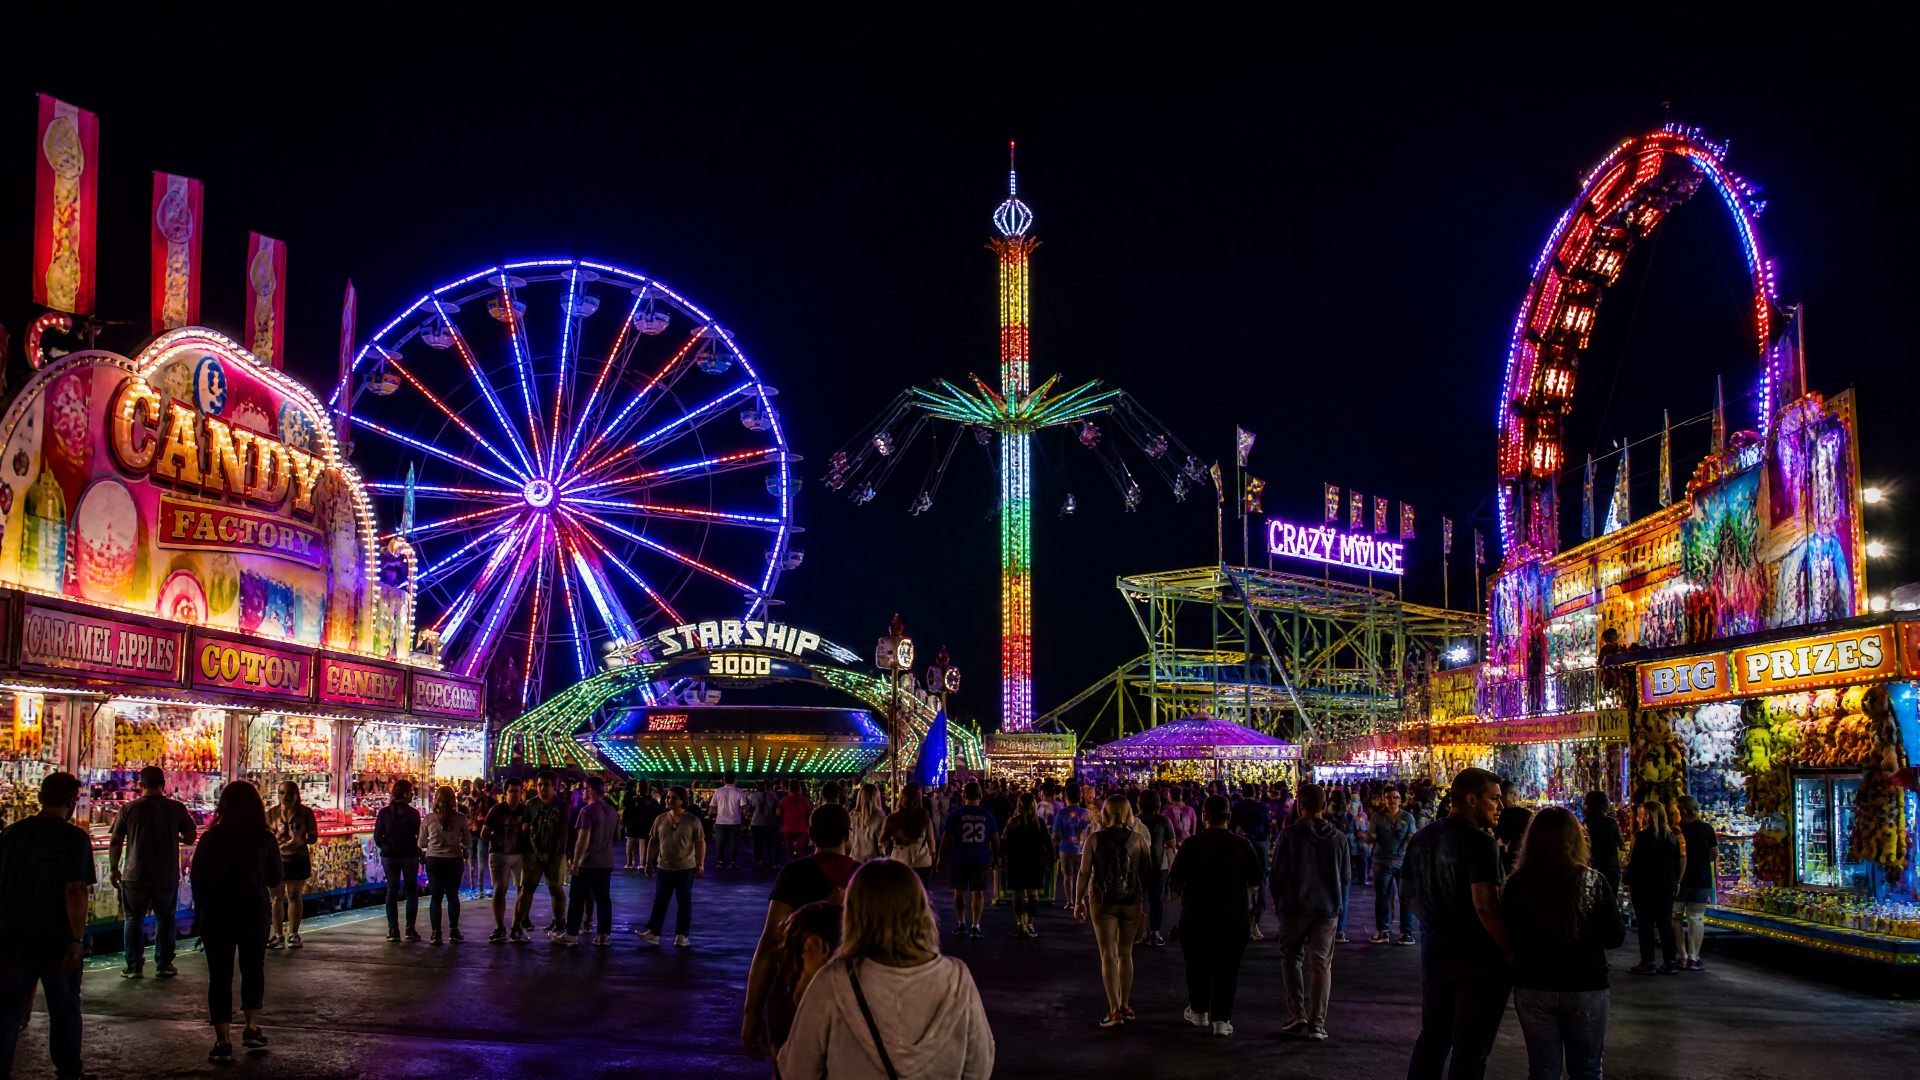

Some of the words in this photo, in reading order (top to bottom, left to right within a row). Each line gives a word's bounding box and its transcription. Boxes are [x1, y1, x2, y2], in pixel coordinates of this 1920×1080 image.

[108, 377, 325, 520] CANDY
[172, 509, 313, 556] FACTORY
[1270, 520, 1336, 559] CRAZY
[1340, 534, 1404, 571] MOUSE
[27, 614, 112, 667] CARAMEL
[116, 630, 174, 673] APPLES
[658, 620, 820, 656] STARSHIP
[709, 657, 770, 674] 3000
[1652, 661, 1717, 697] BIG
[1746, 636, 1882, 683] PRIZES
[415, 679, 477, 712] POPCORN
[962, 823, 985, 842] 23
